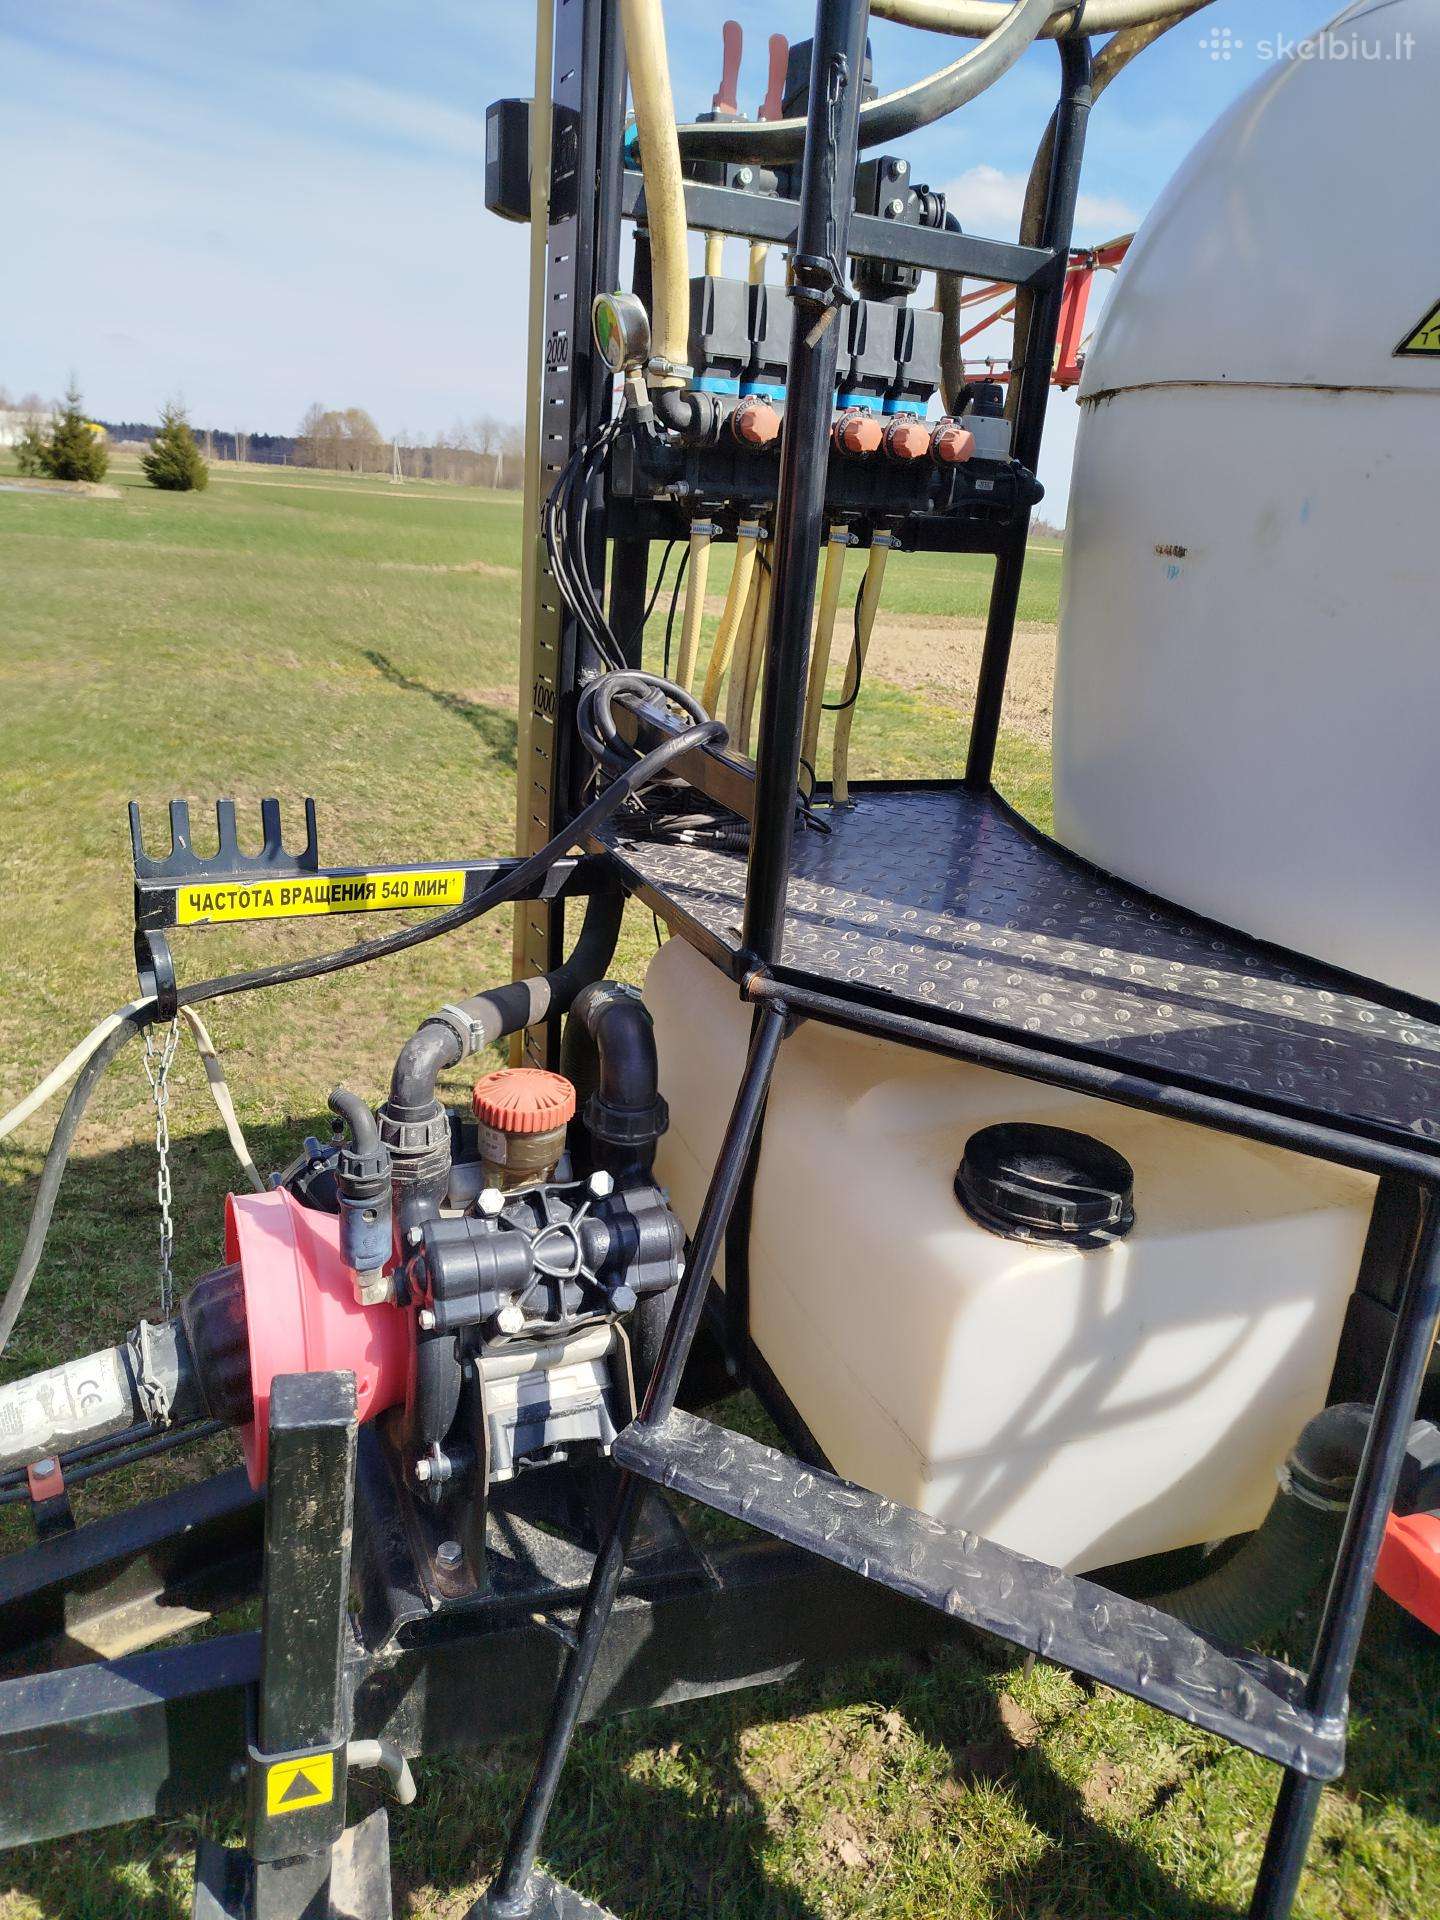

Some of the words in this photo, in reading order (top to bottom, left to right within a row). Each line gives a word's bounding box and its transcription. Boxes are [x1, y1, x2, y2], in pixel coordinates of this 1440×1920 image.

[546, 337, 568, 364] 2000
[533, 682, 555, 714] 1000
[189, 889, 274, 912] ЧАСТОТА
[280, 883, 376, 907] ВРАЩЕНИЯ
[381, 880, 409, 899] 540
